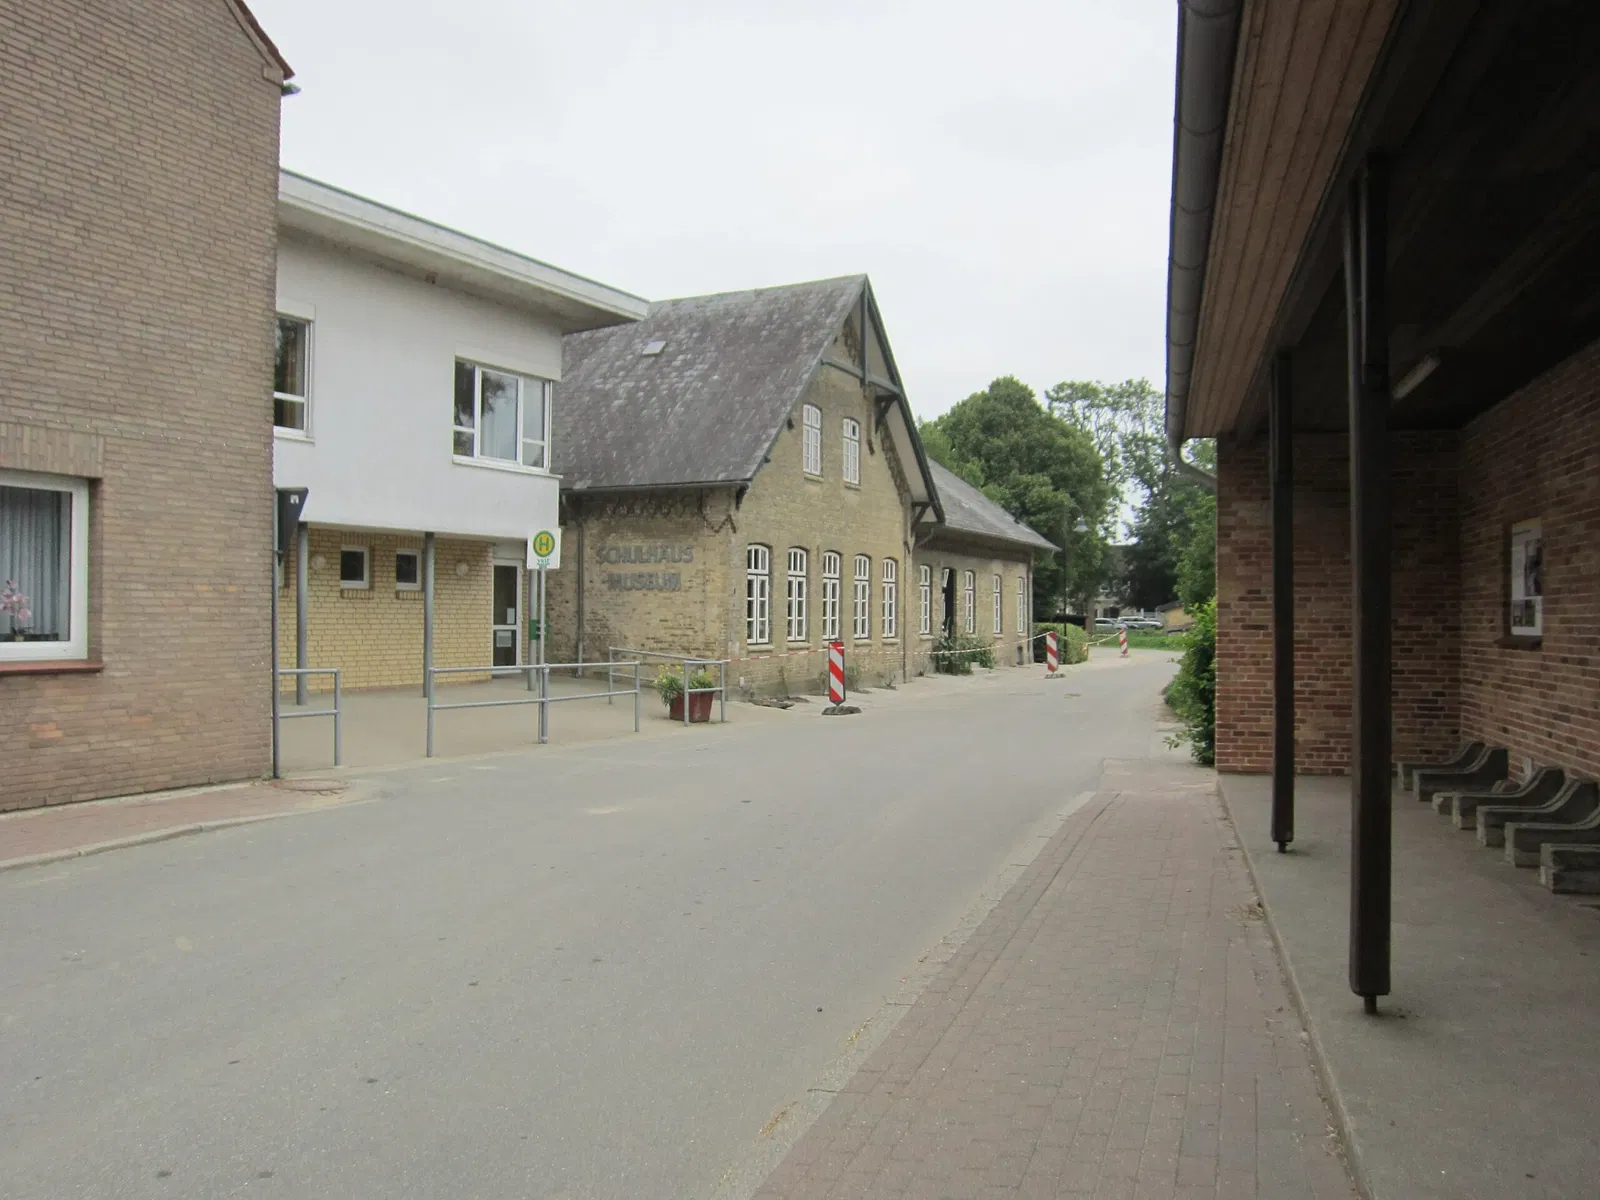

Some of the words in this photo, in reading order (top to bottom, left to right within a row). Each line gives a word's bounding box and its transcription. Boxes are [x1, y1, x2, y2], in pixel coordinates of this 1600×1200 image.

[539, 536, 549, 551] H
[596, 545, 694, 564] SCHULHAUS
[607, 572, 681, 591] MUSEUM
